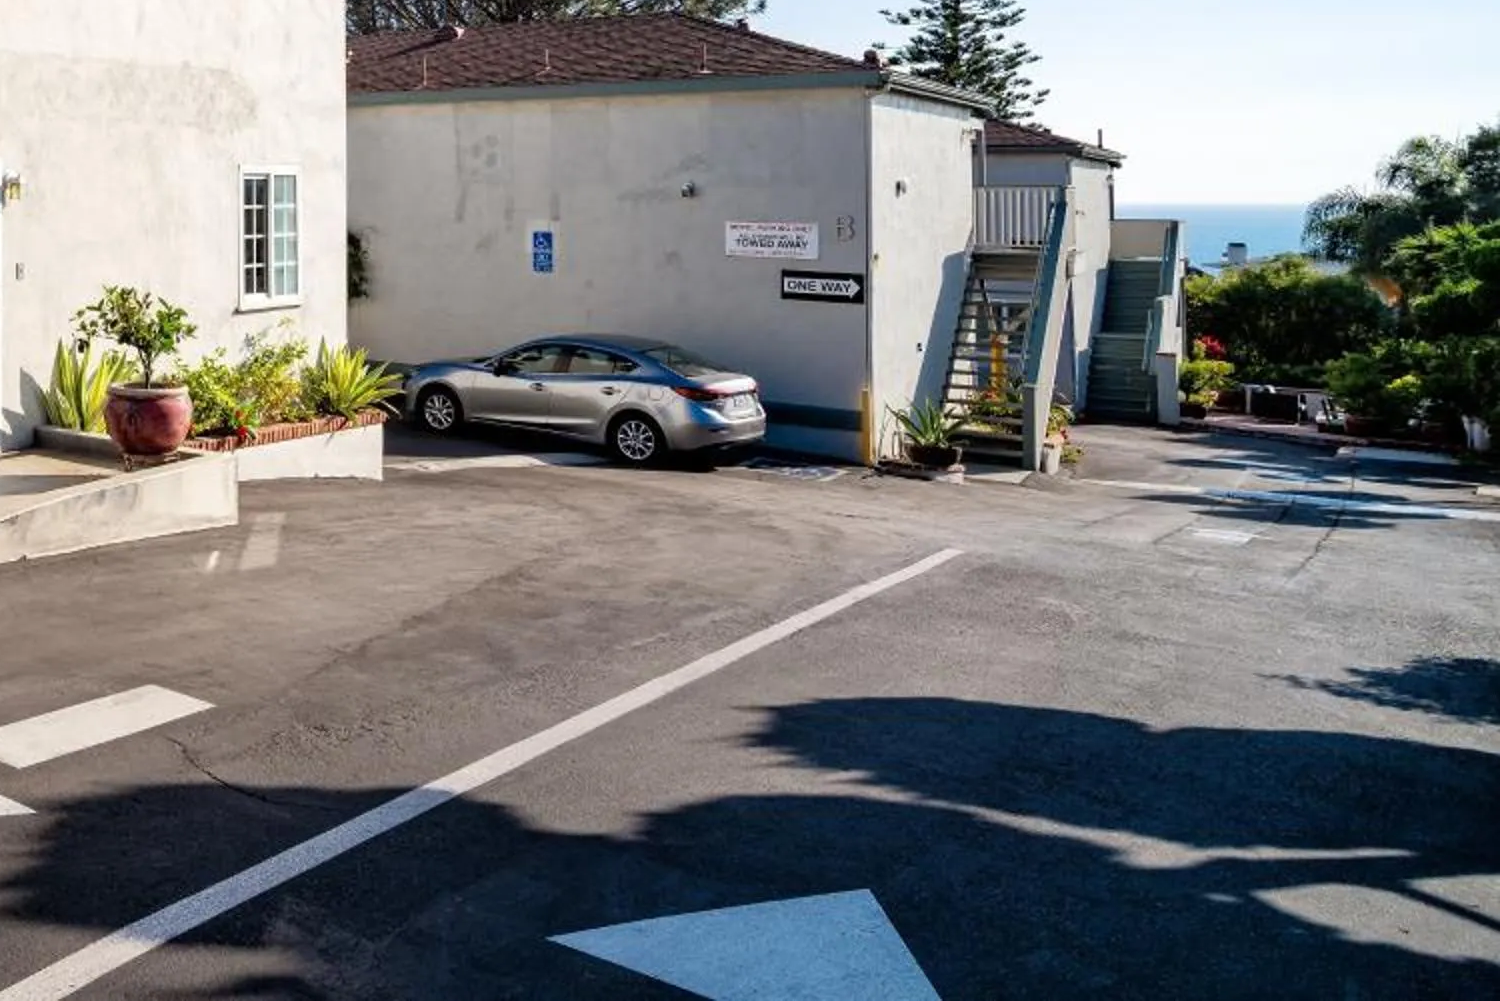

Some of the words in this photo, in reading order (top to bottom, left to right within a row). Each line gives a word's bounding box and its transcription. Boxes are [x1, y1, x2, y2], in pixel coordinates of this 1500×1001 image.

[735, 238, 774, 248] TOWED
[777, 239, 809, 249] AWAY
[786, 280, 817, 292] ONE
[820, 280, 852, 293] WAY
